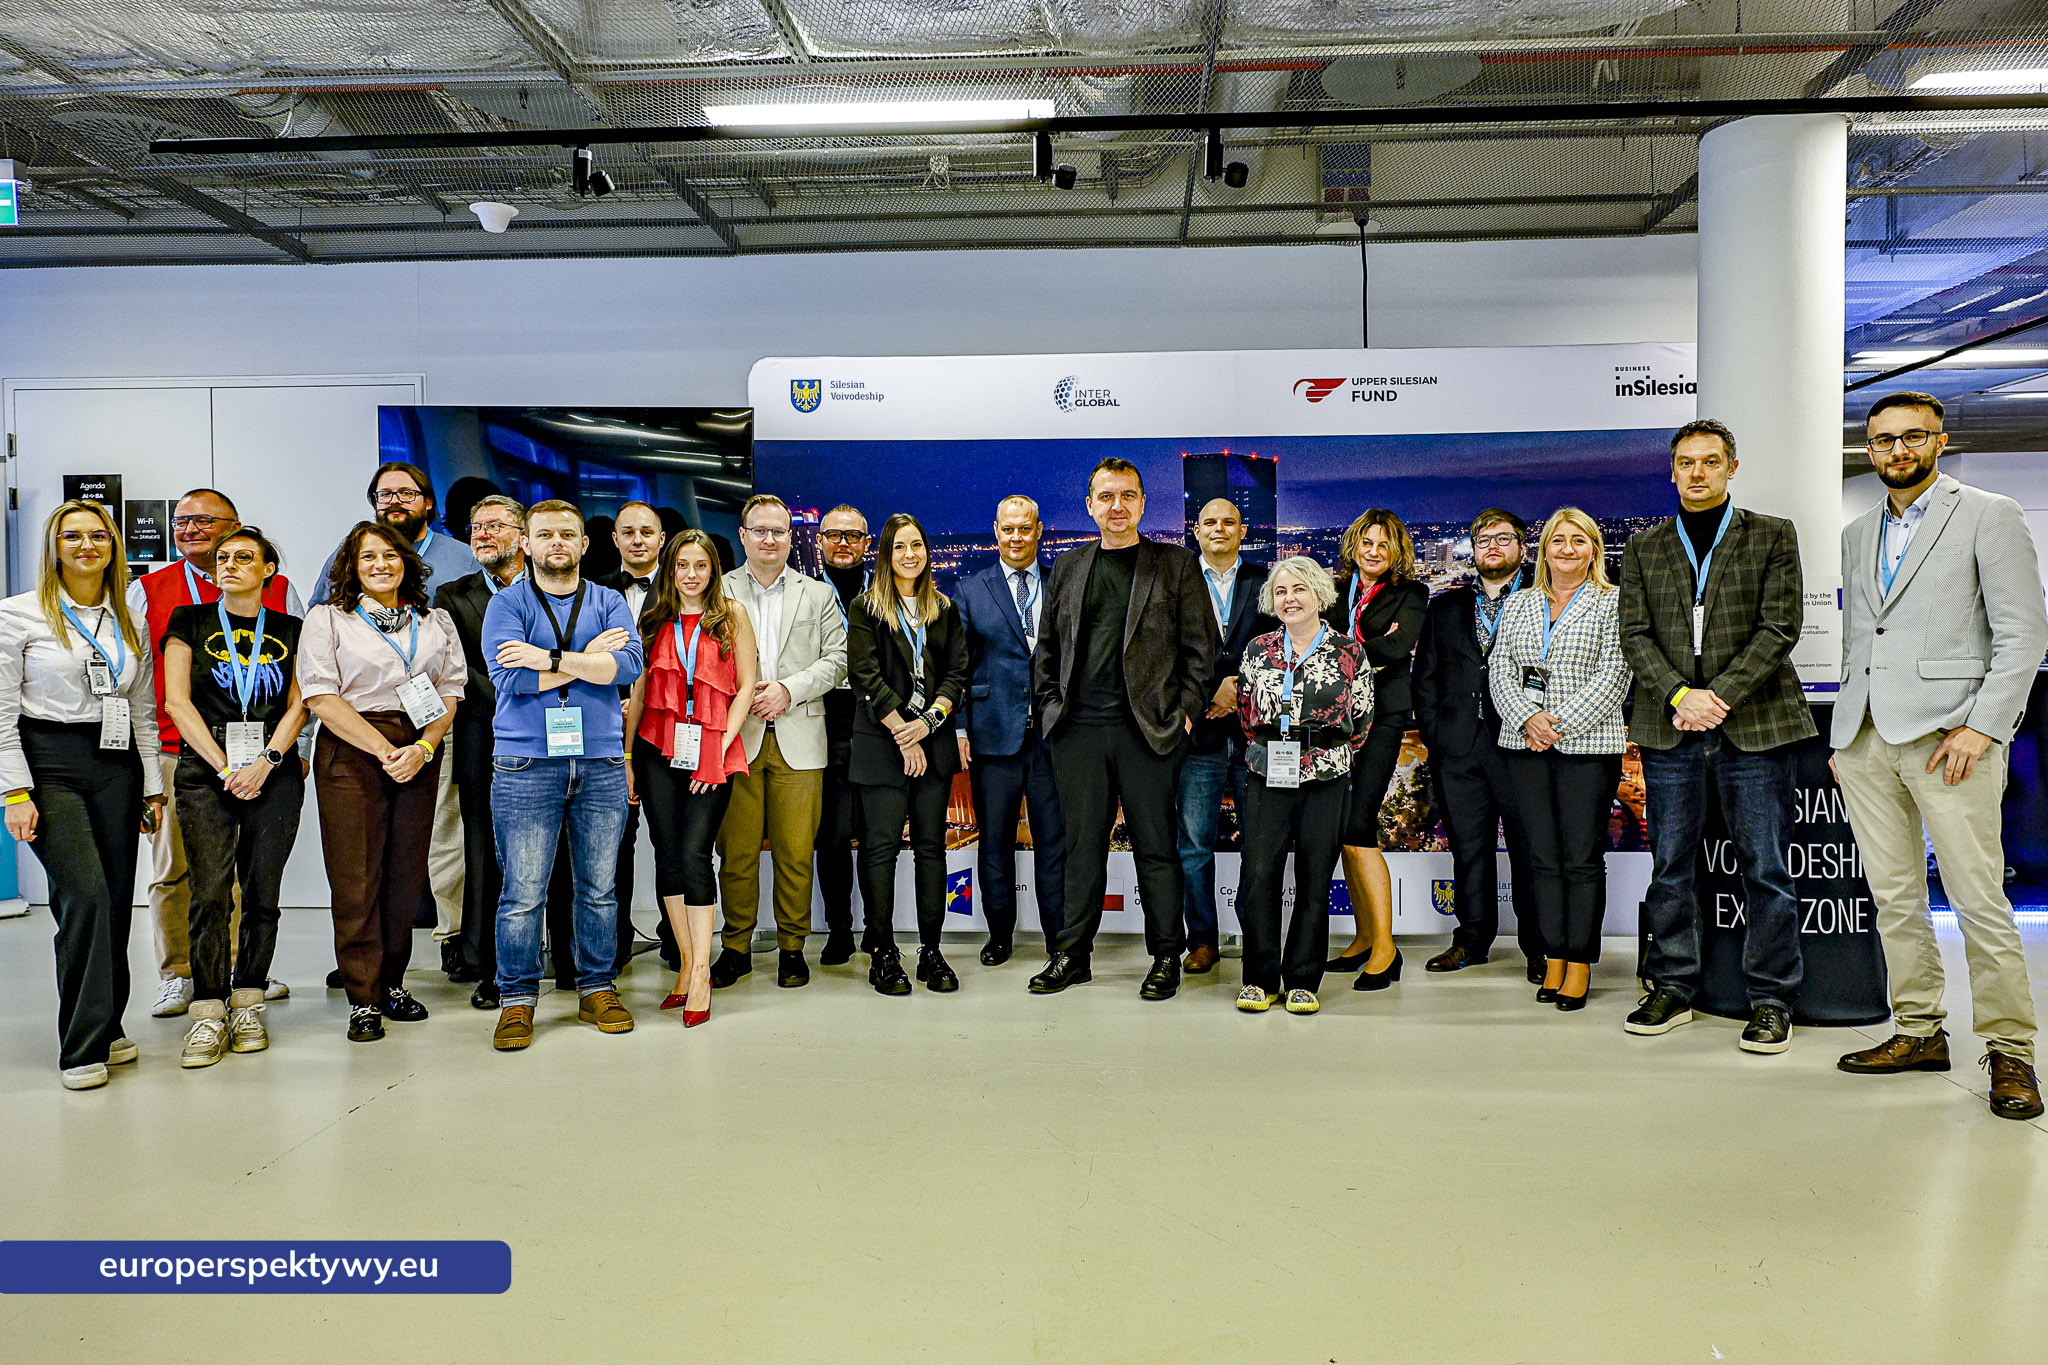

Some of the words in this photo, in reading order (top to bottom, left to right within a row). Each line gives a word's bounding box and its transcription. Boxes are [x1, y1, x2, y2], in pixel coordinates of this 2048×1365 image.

[830, 380, 865, 389] Silesian
[1351, 377, 1388, 386] UPPER
[1390, 376, 1438, 385] SILESIAN
[1615, 374, 1698, 397] inSilesia
[830, 392, 885, 402] Voivodeship
[1075, 389, 1111, 398] INTER
[1352, 390, 1398, 402] FUND
[1074, 398, 1120, 407] GLOBAL
[80, 482, 106, 491] Agenda
[136, 517, 154, 525] Wi-Fi
[1801, 898, 1869, 934] ZONE
